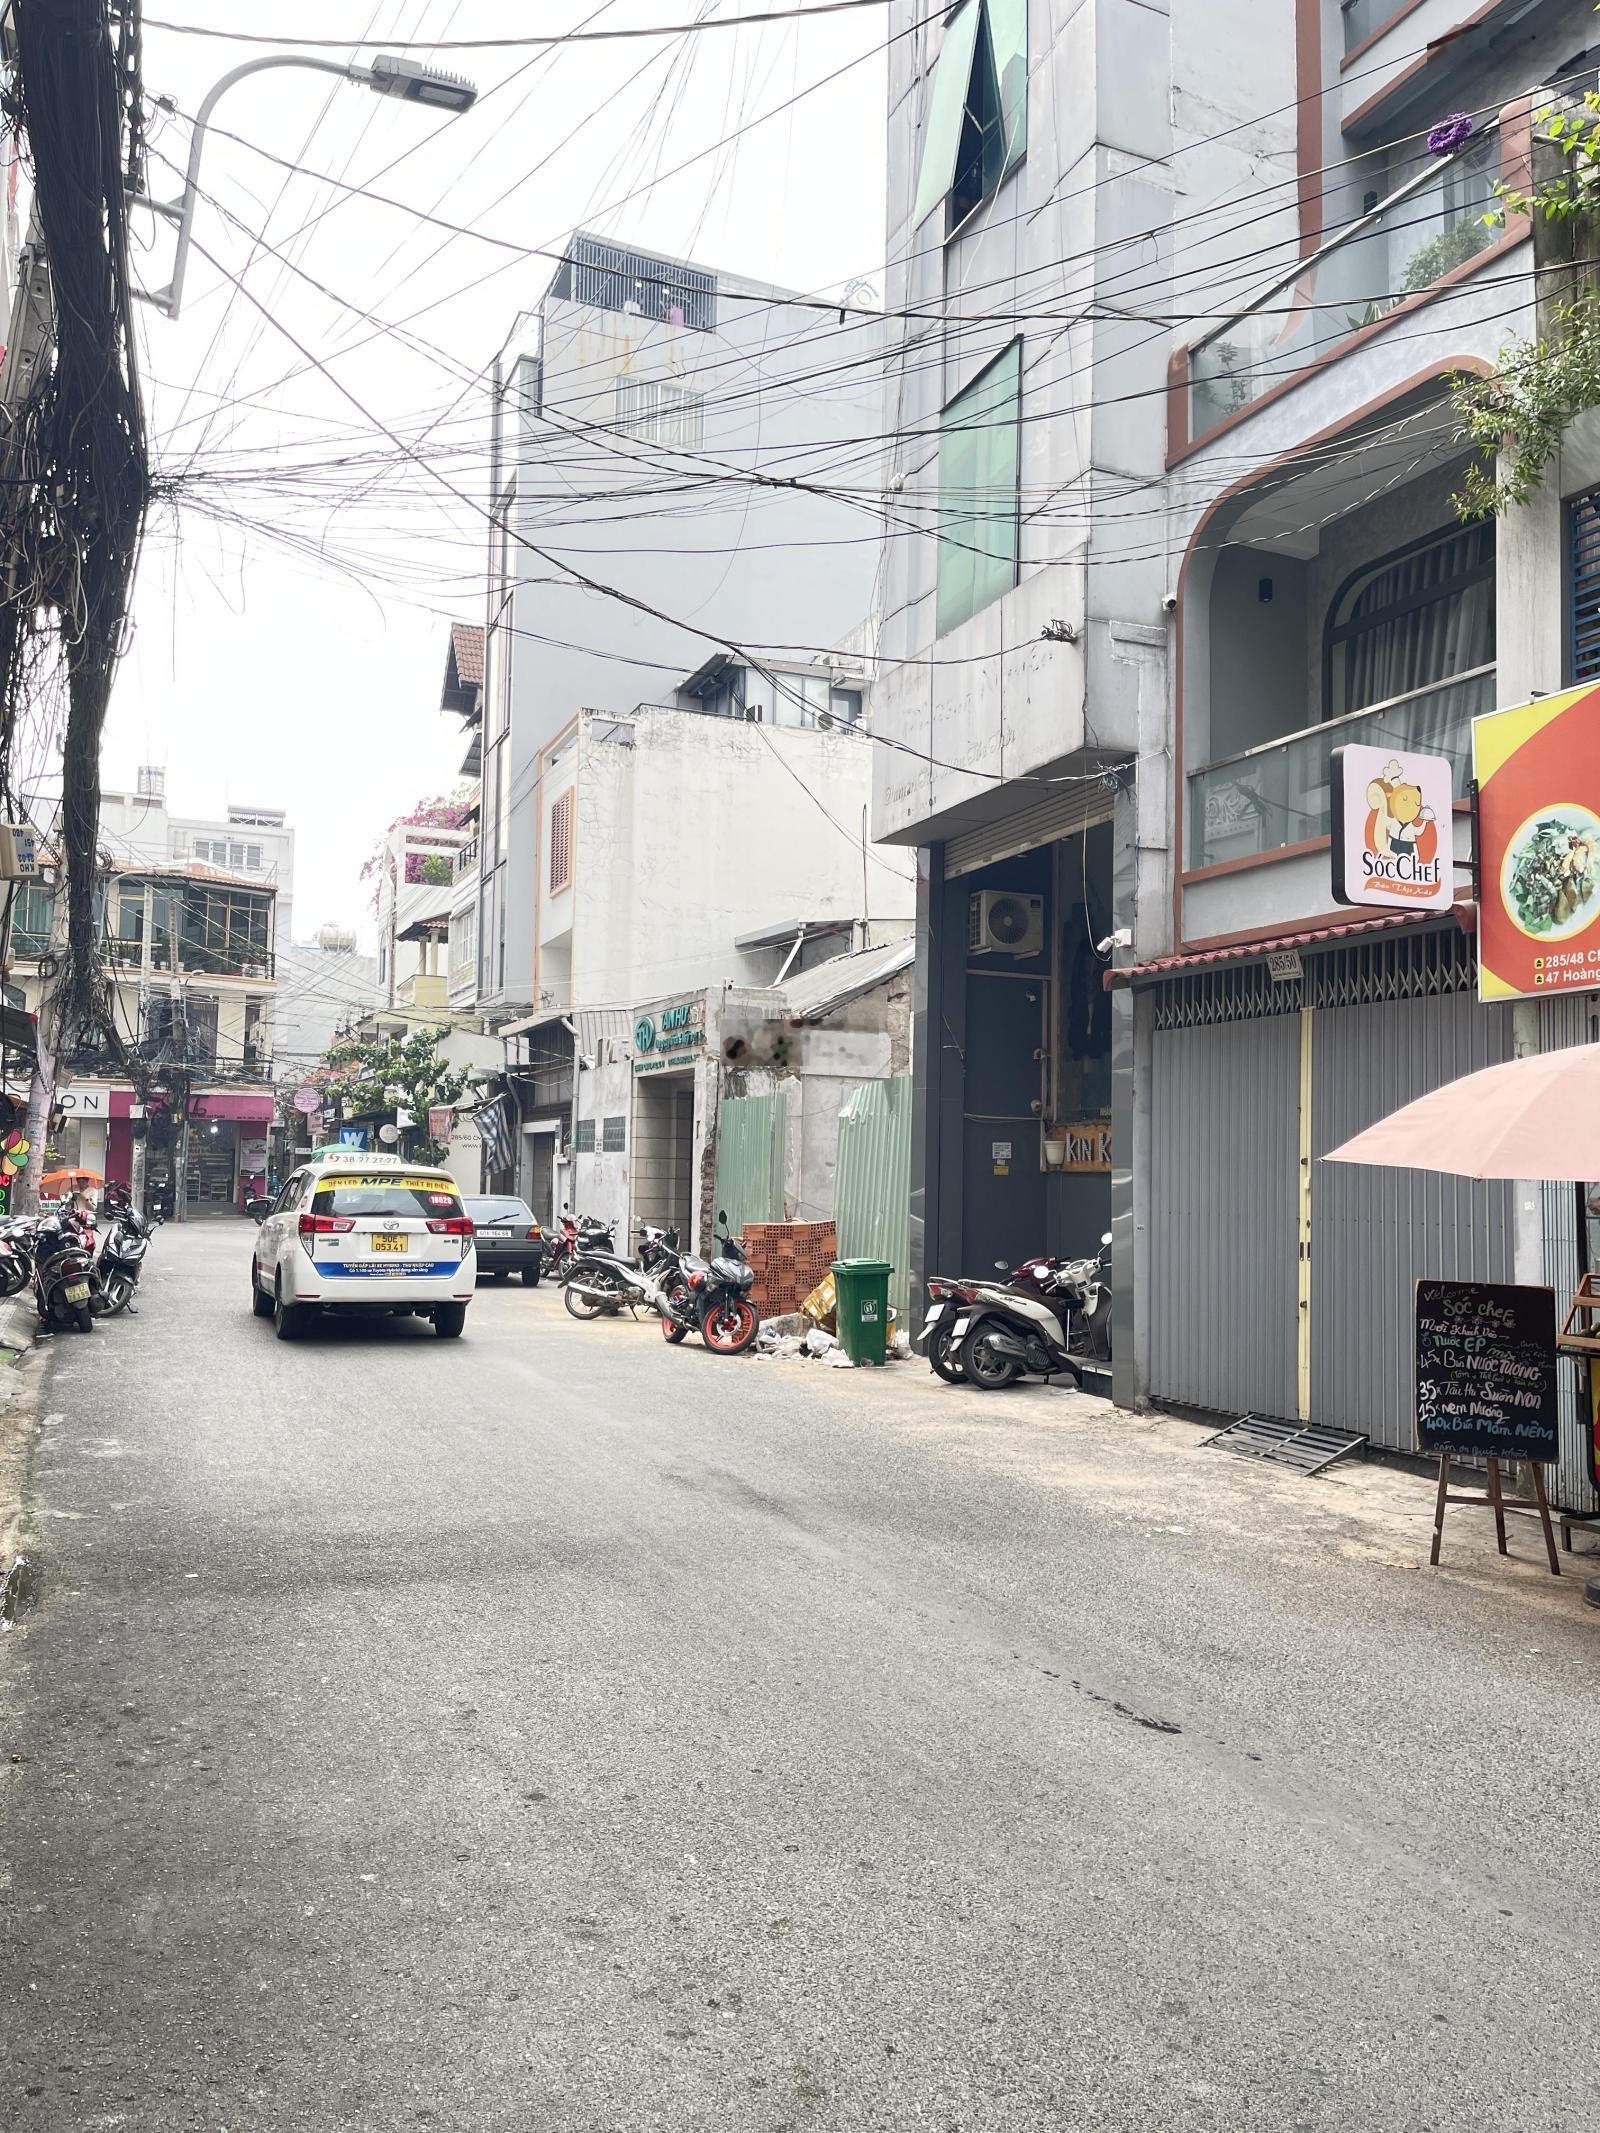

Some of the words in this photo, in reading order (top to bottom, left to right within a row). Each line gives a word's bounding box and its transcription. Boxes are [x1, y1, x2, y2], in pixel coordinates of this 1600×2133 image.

[1545, 952, 1584, 968] 285/48
[1545, 971, 1560, 984] 47
[1065, 1132, 1092, 1162] KIN
[360, 1177, 404, 1186] MPE
